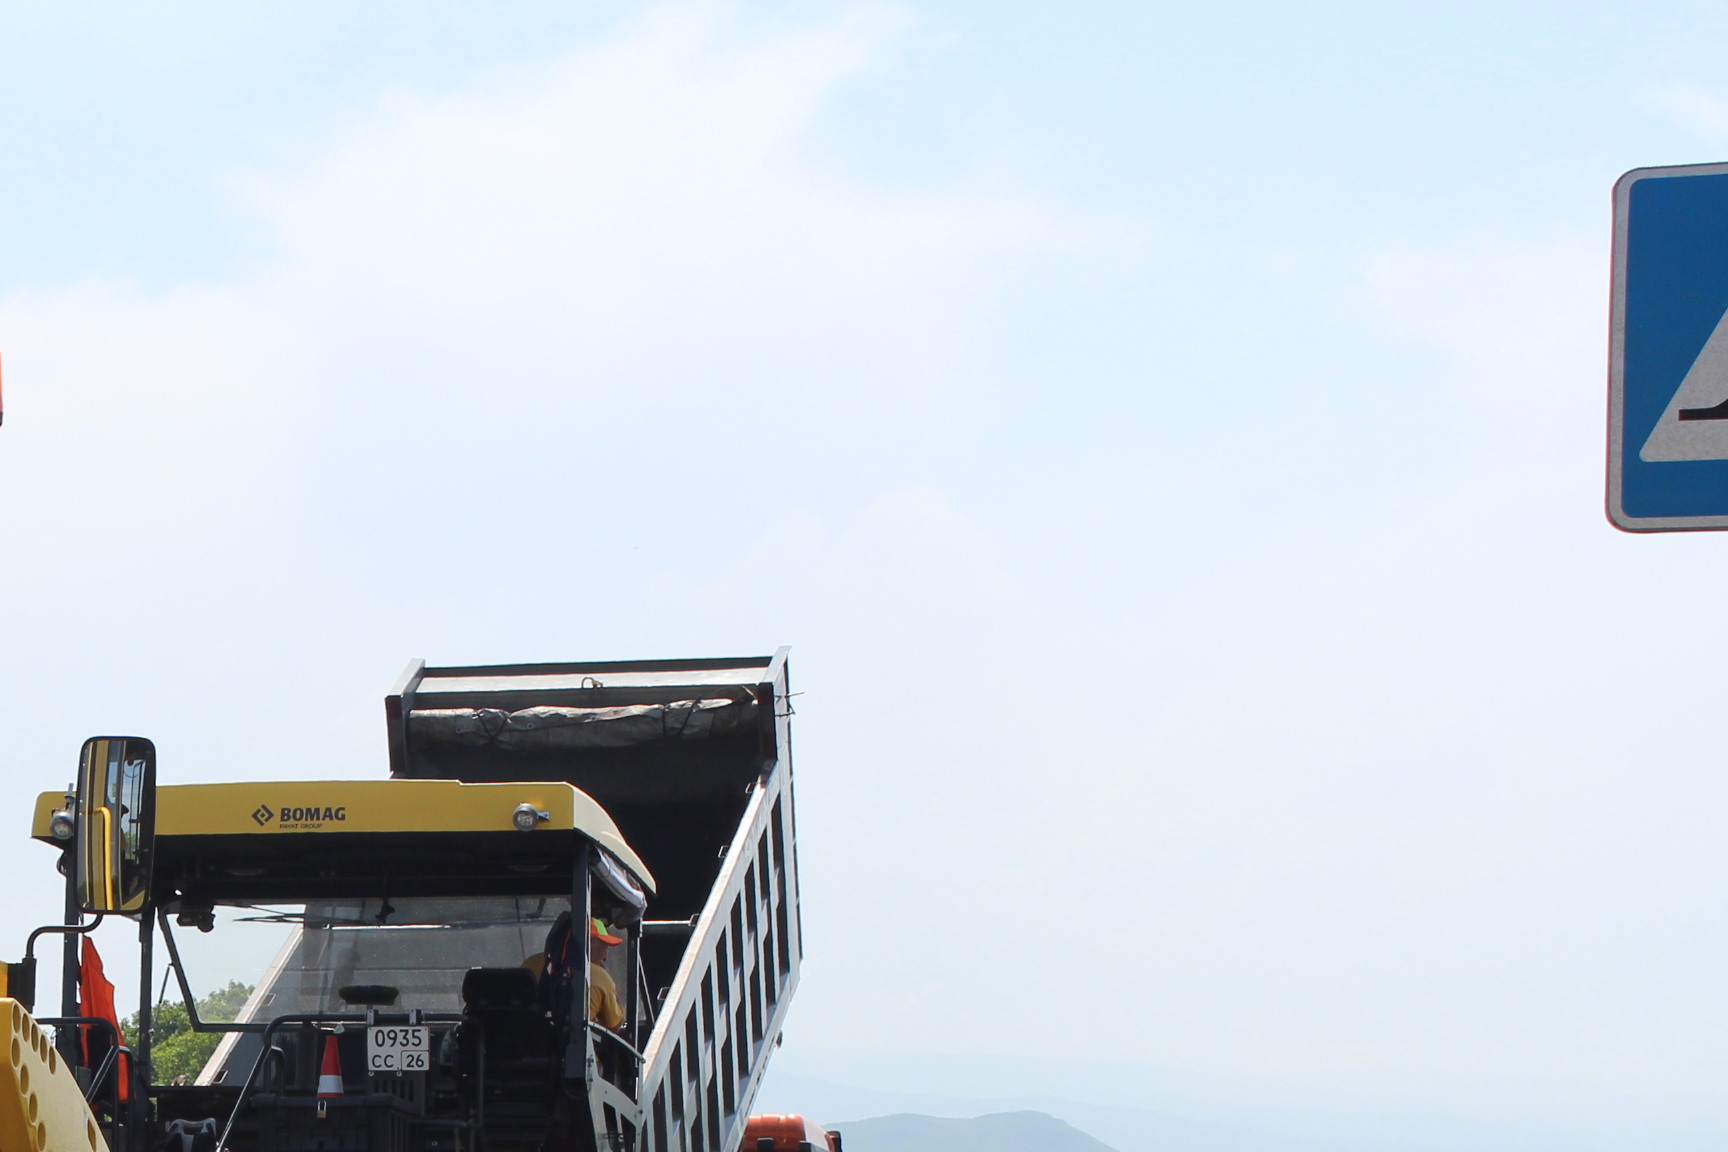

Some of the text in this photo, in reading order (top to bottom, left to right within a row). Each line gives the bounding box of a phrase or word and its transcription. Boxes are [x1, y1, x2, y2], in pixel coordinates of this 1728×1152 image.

[279, 806, 346, 822] BOMAG
[375, 1029, 422, 1048] 0935
[371, 1054, 424, 1069] CC 26
